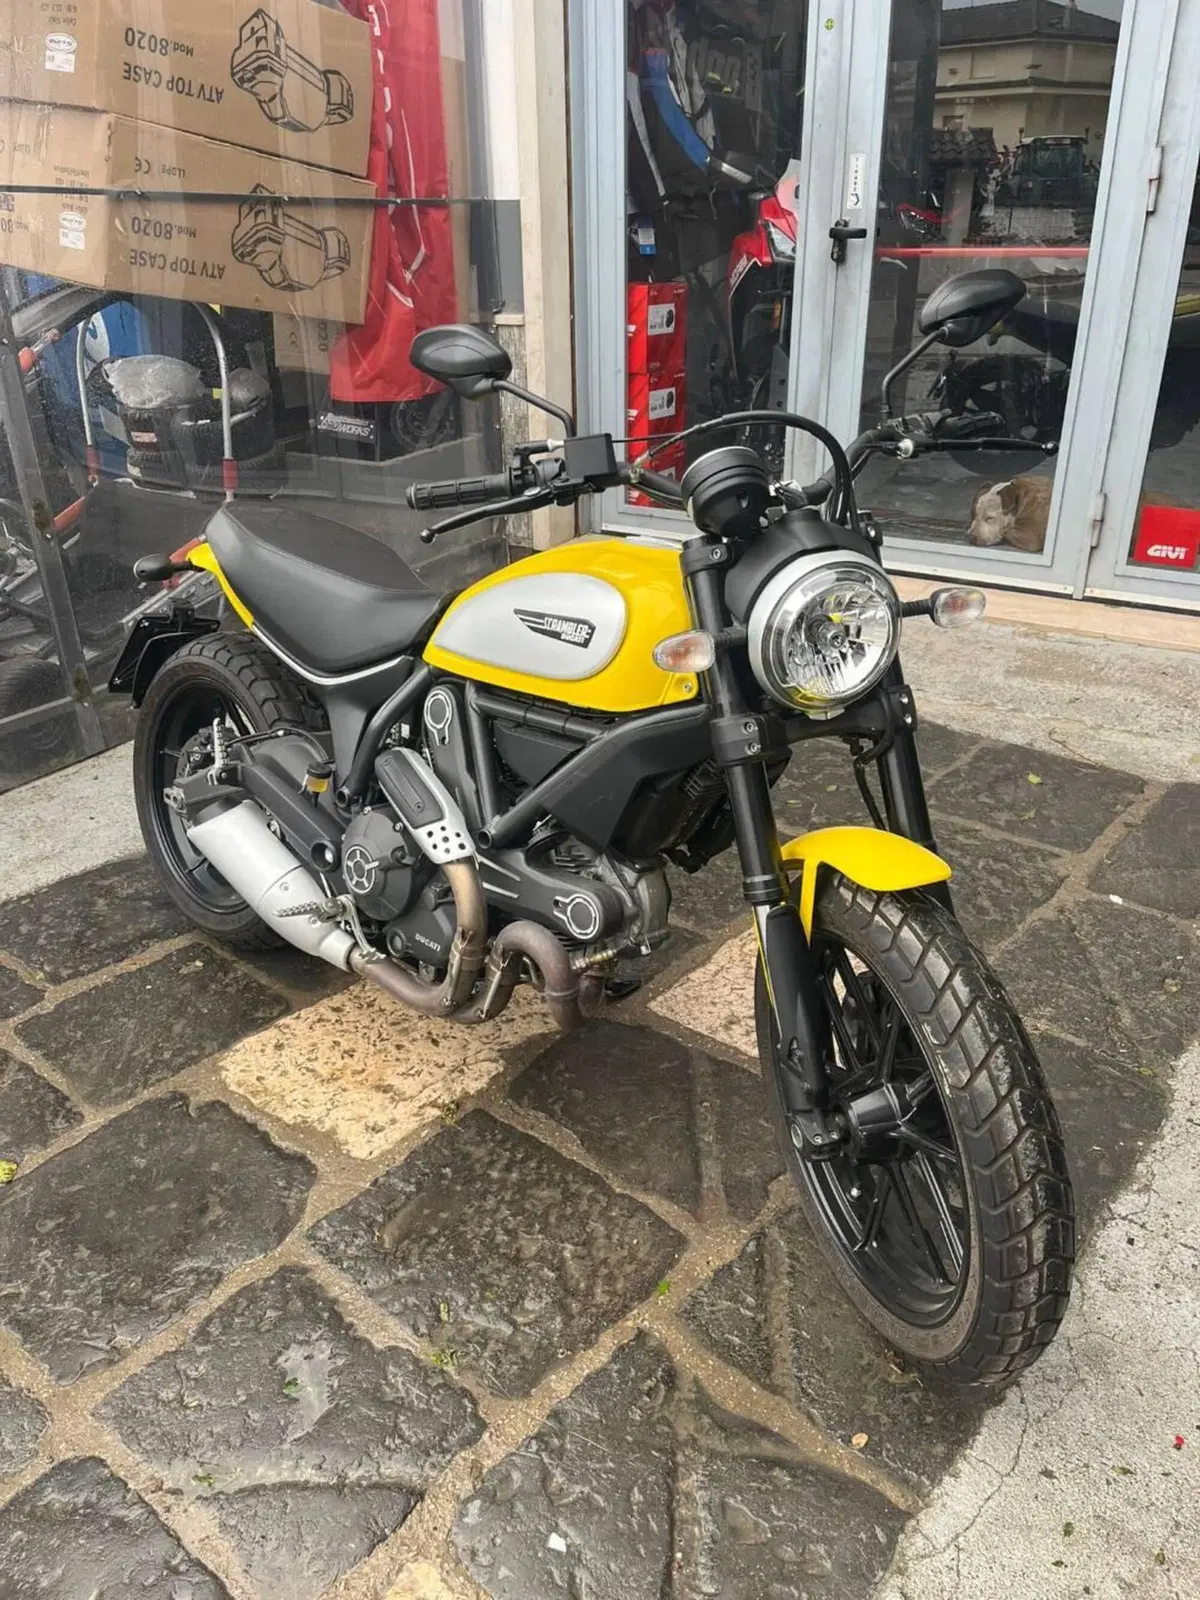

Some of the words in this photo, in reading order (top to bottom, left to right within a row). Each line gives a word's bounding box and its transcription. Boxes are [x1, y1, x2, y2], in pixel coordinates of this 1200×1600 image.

[123, 61, 162, 88] CASE
[166, 75, 194, 97] TOP
[197, 83, 224, 104] ATV
[129, 248, 167, 270] CASE
[170, 256, 197, 275] TOP
[200, 261, 226, 280] ATV
[1146, 544, 1190, 560] GIVI
[415, 933, 441, 952] DUCATI
